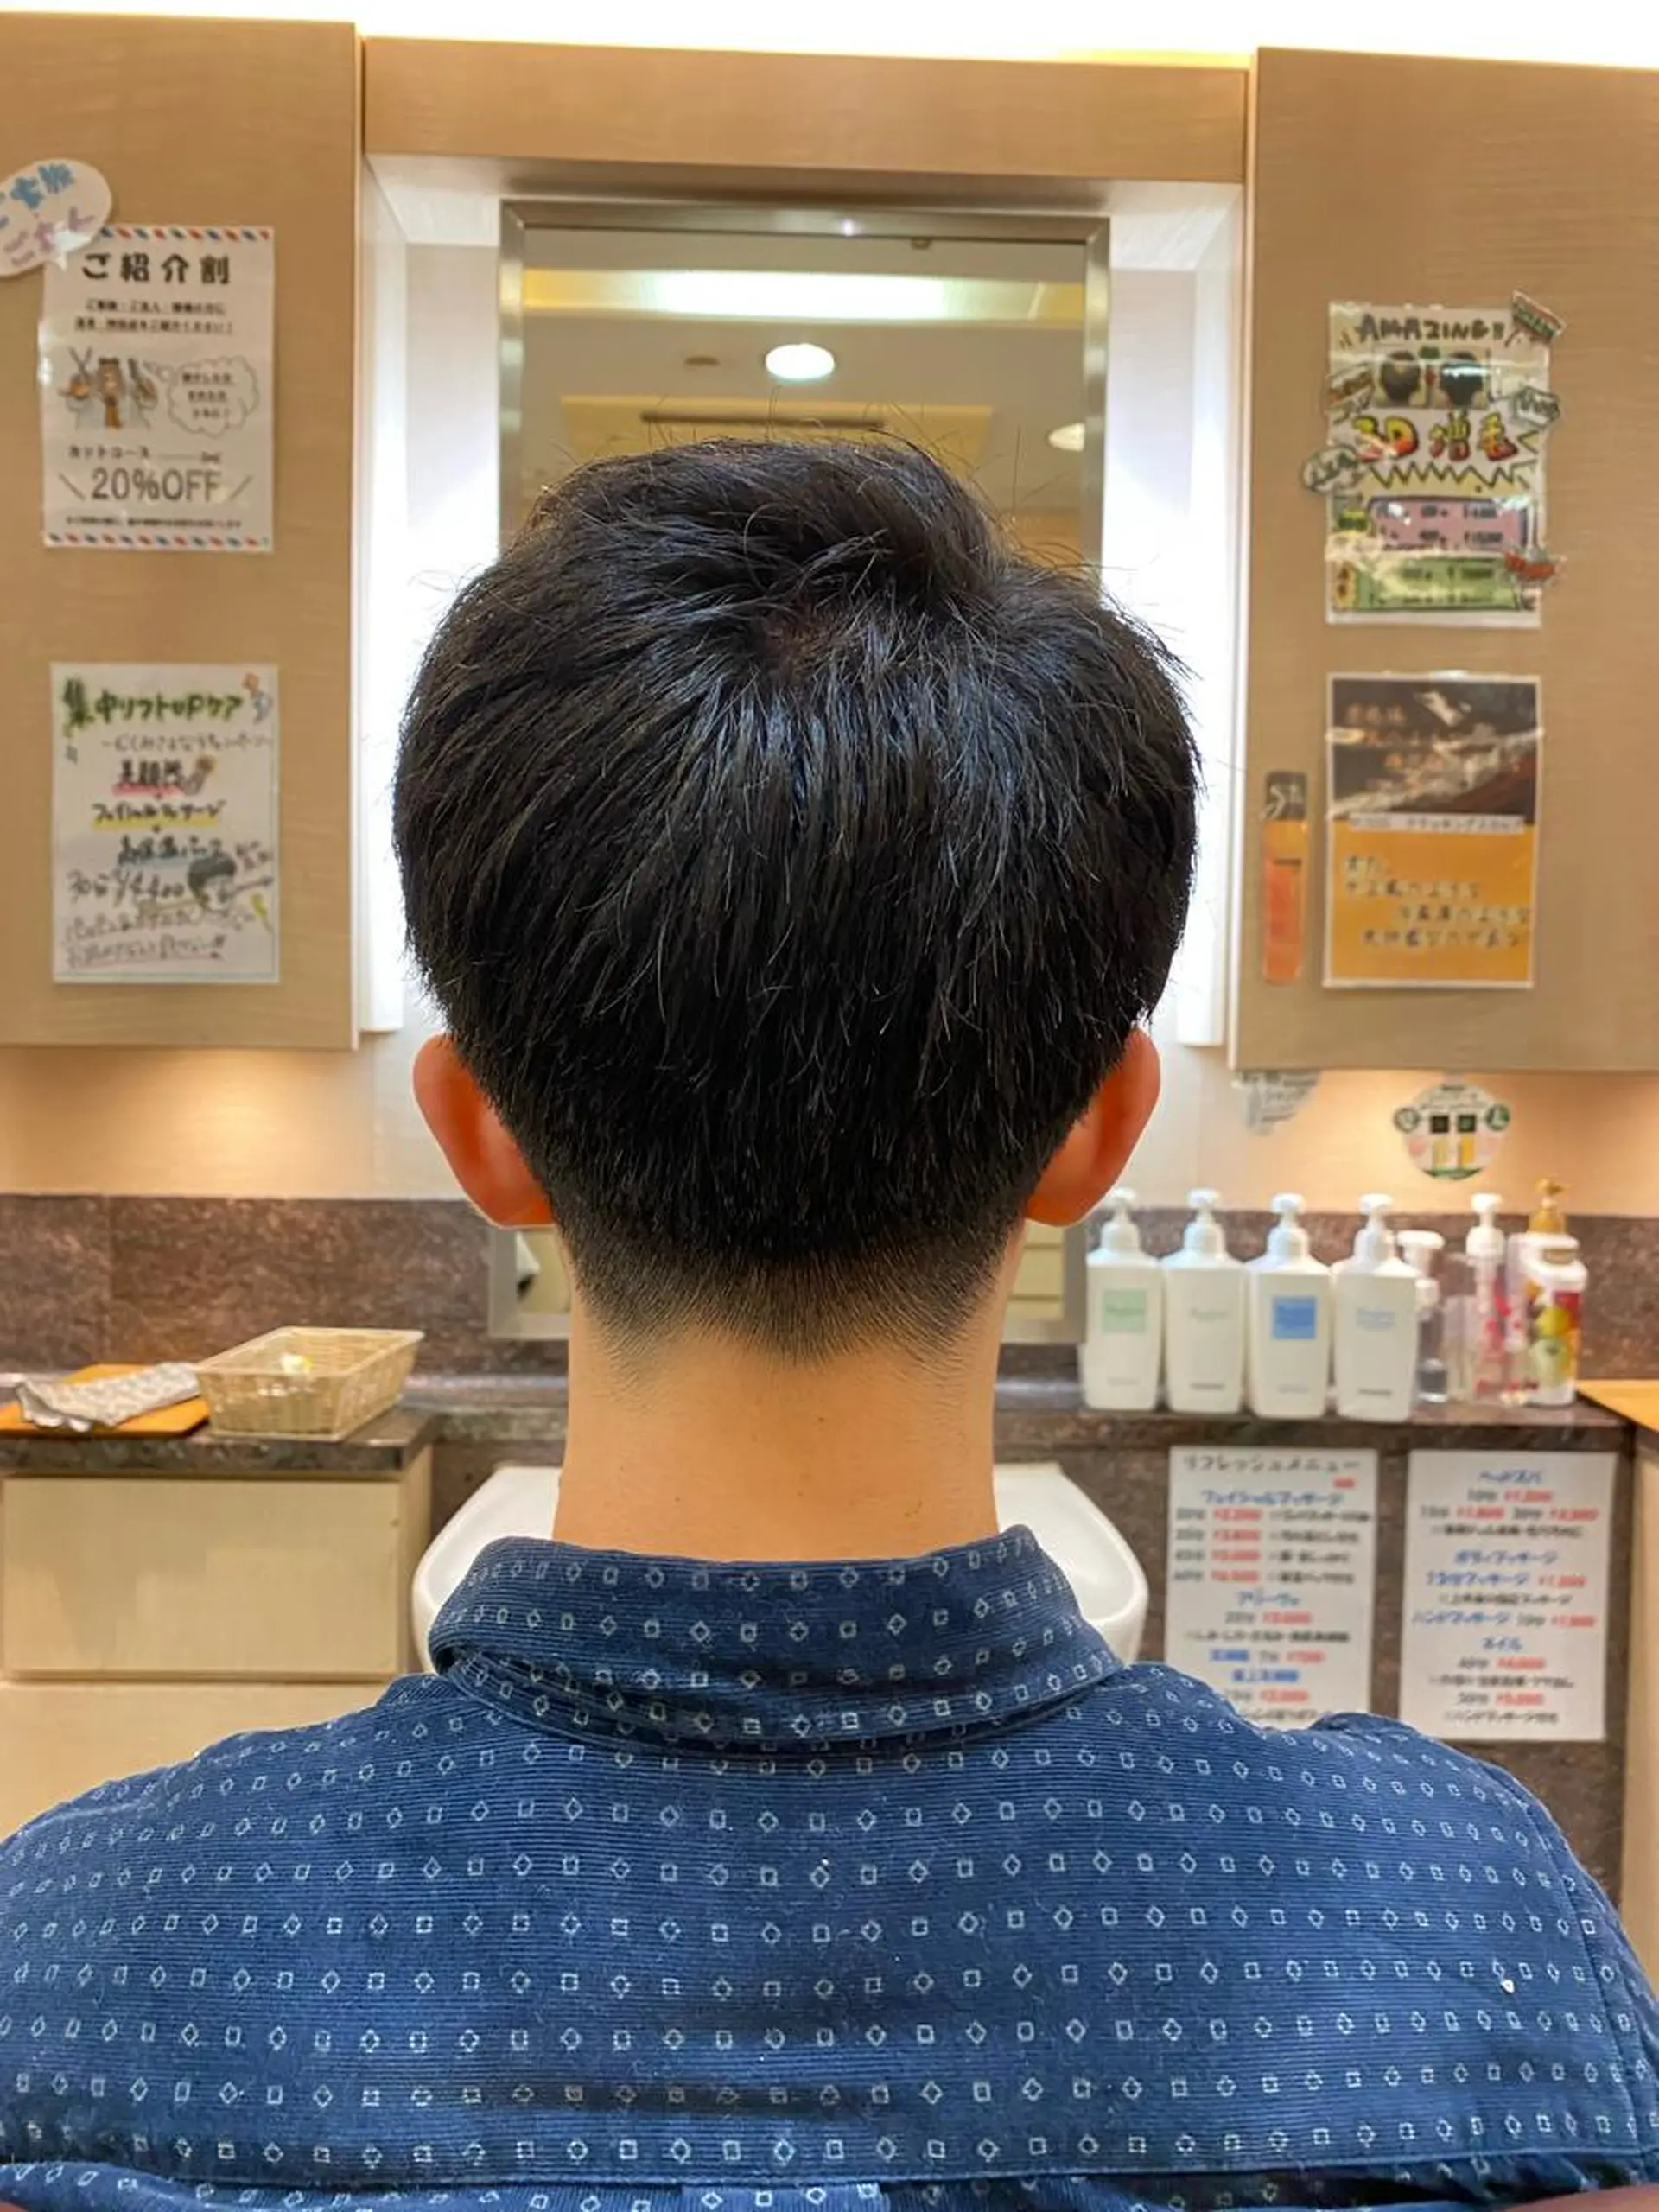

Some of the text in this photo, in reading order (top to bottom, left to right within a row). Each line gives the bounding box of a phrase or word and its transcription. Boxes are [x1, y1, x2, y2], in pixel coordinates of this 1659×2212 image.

[82, 252, 231, 284] ご紹介割
[91, 467, 221, 502] 20%OFF
